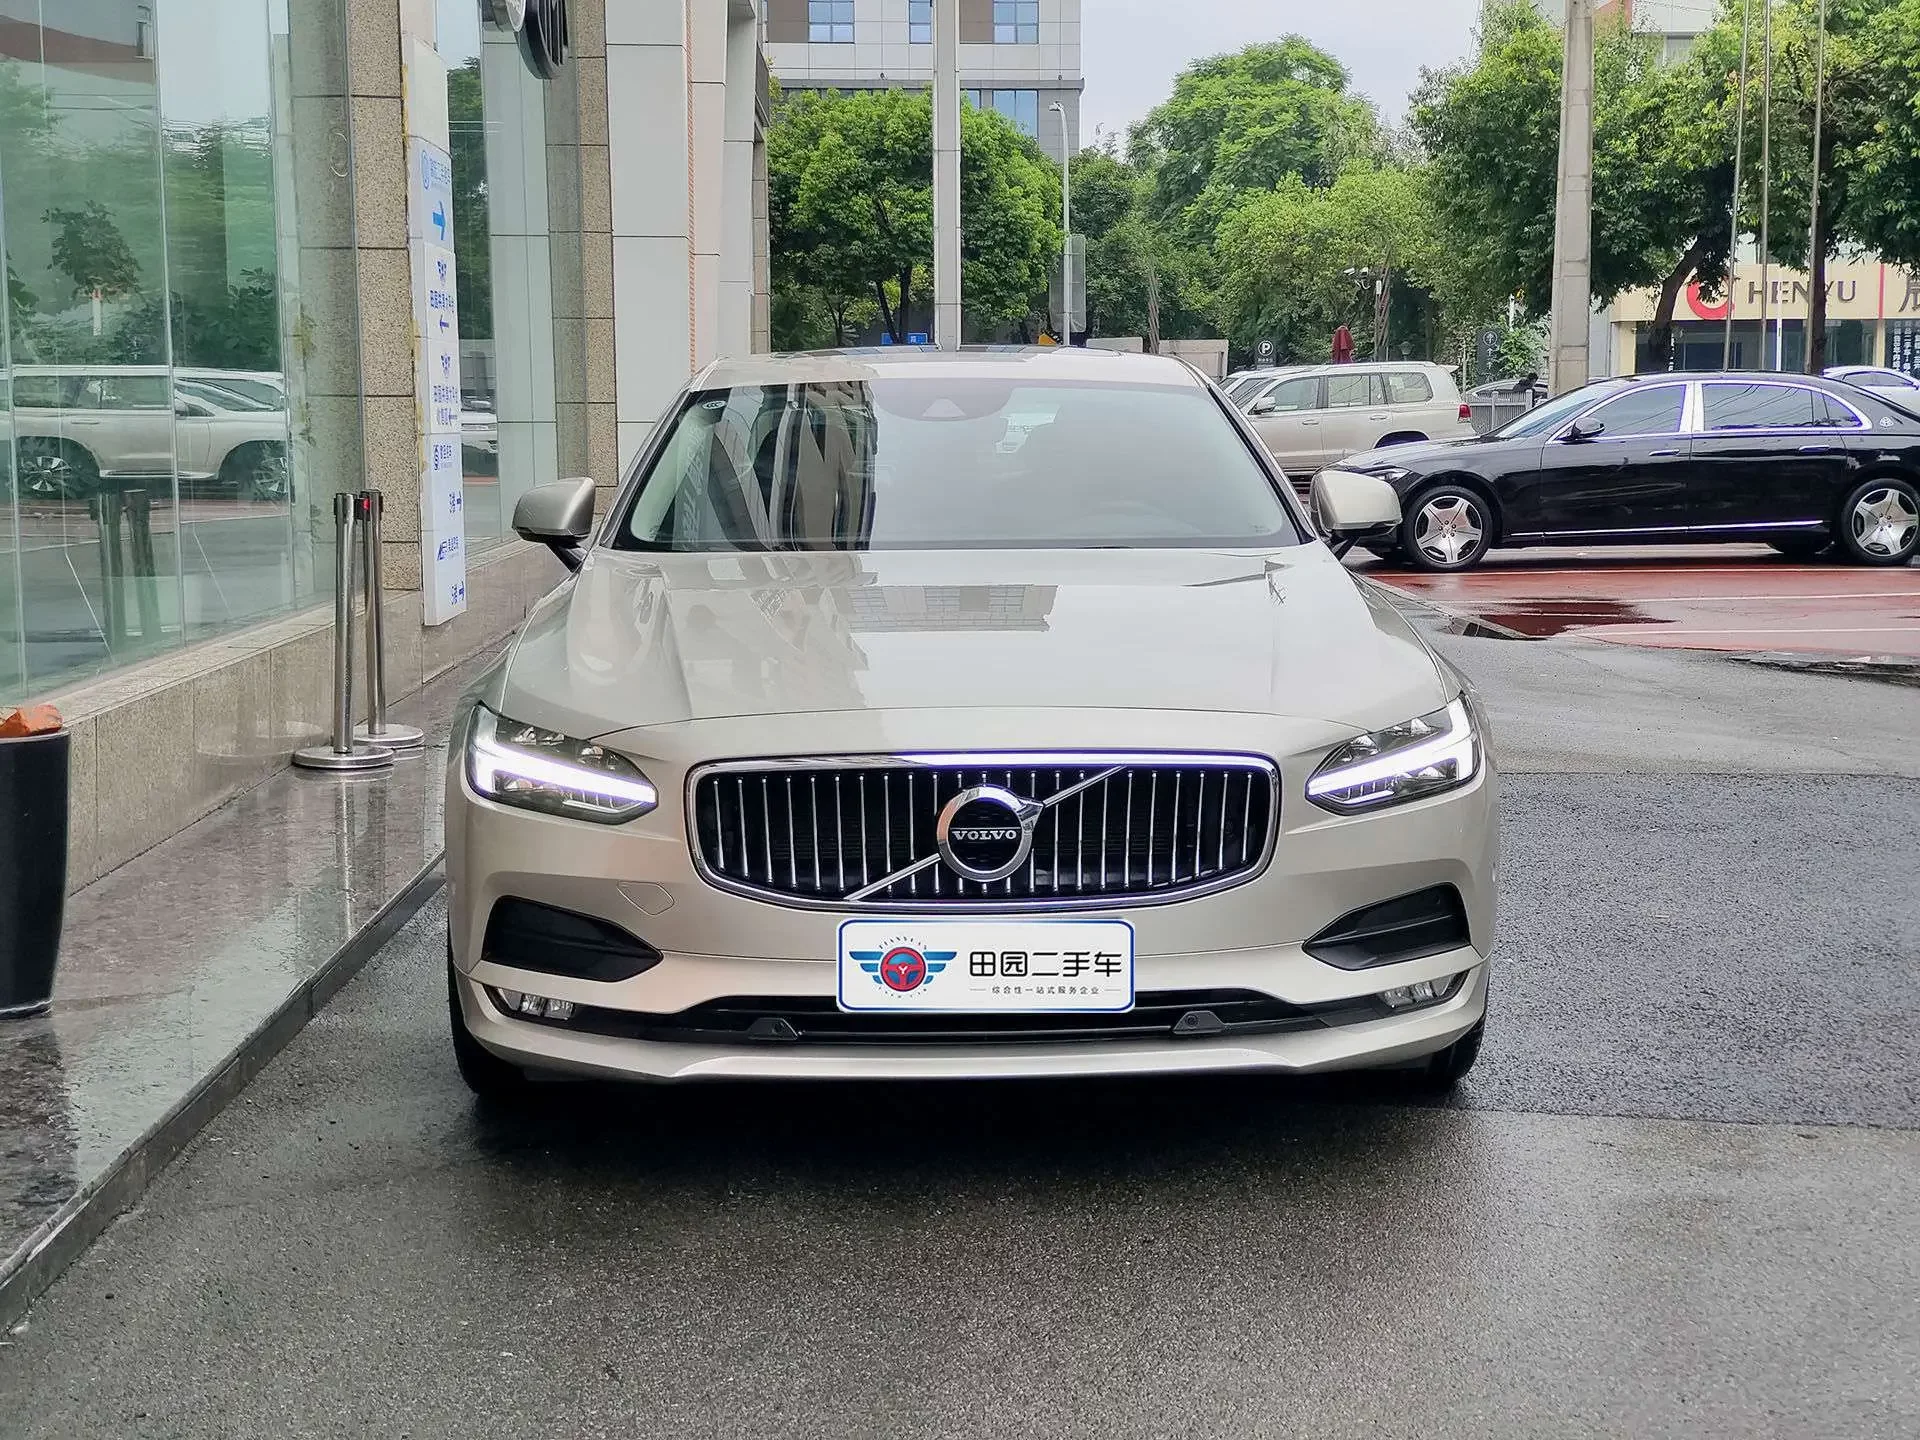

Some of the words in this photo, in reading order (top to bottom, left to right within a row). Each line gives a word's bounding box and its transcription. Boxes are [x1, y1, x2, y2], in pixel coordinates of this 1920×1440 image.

[951, 829, 1017, 840] VOLVO
[969, 951, 1122, 977] 田园二手车
[992, 985, 1100, 995] 综合性一站式服务企业
